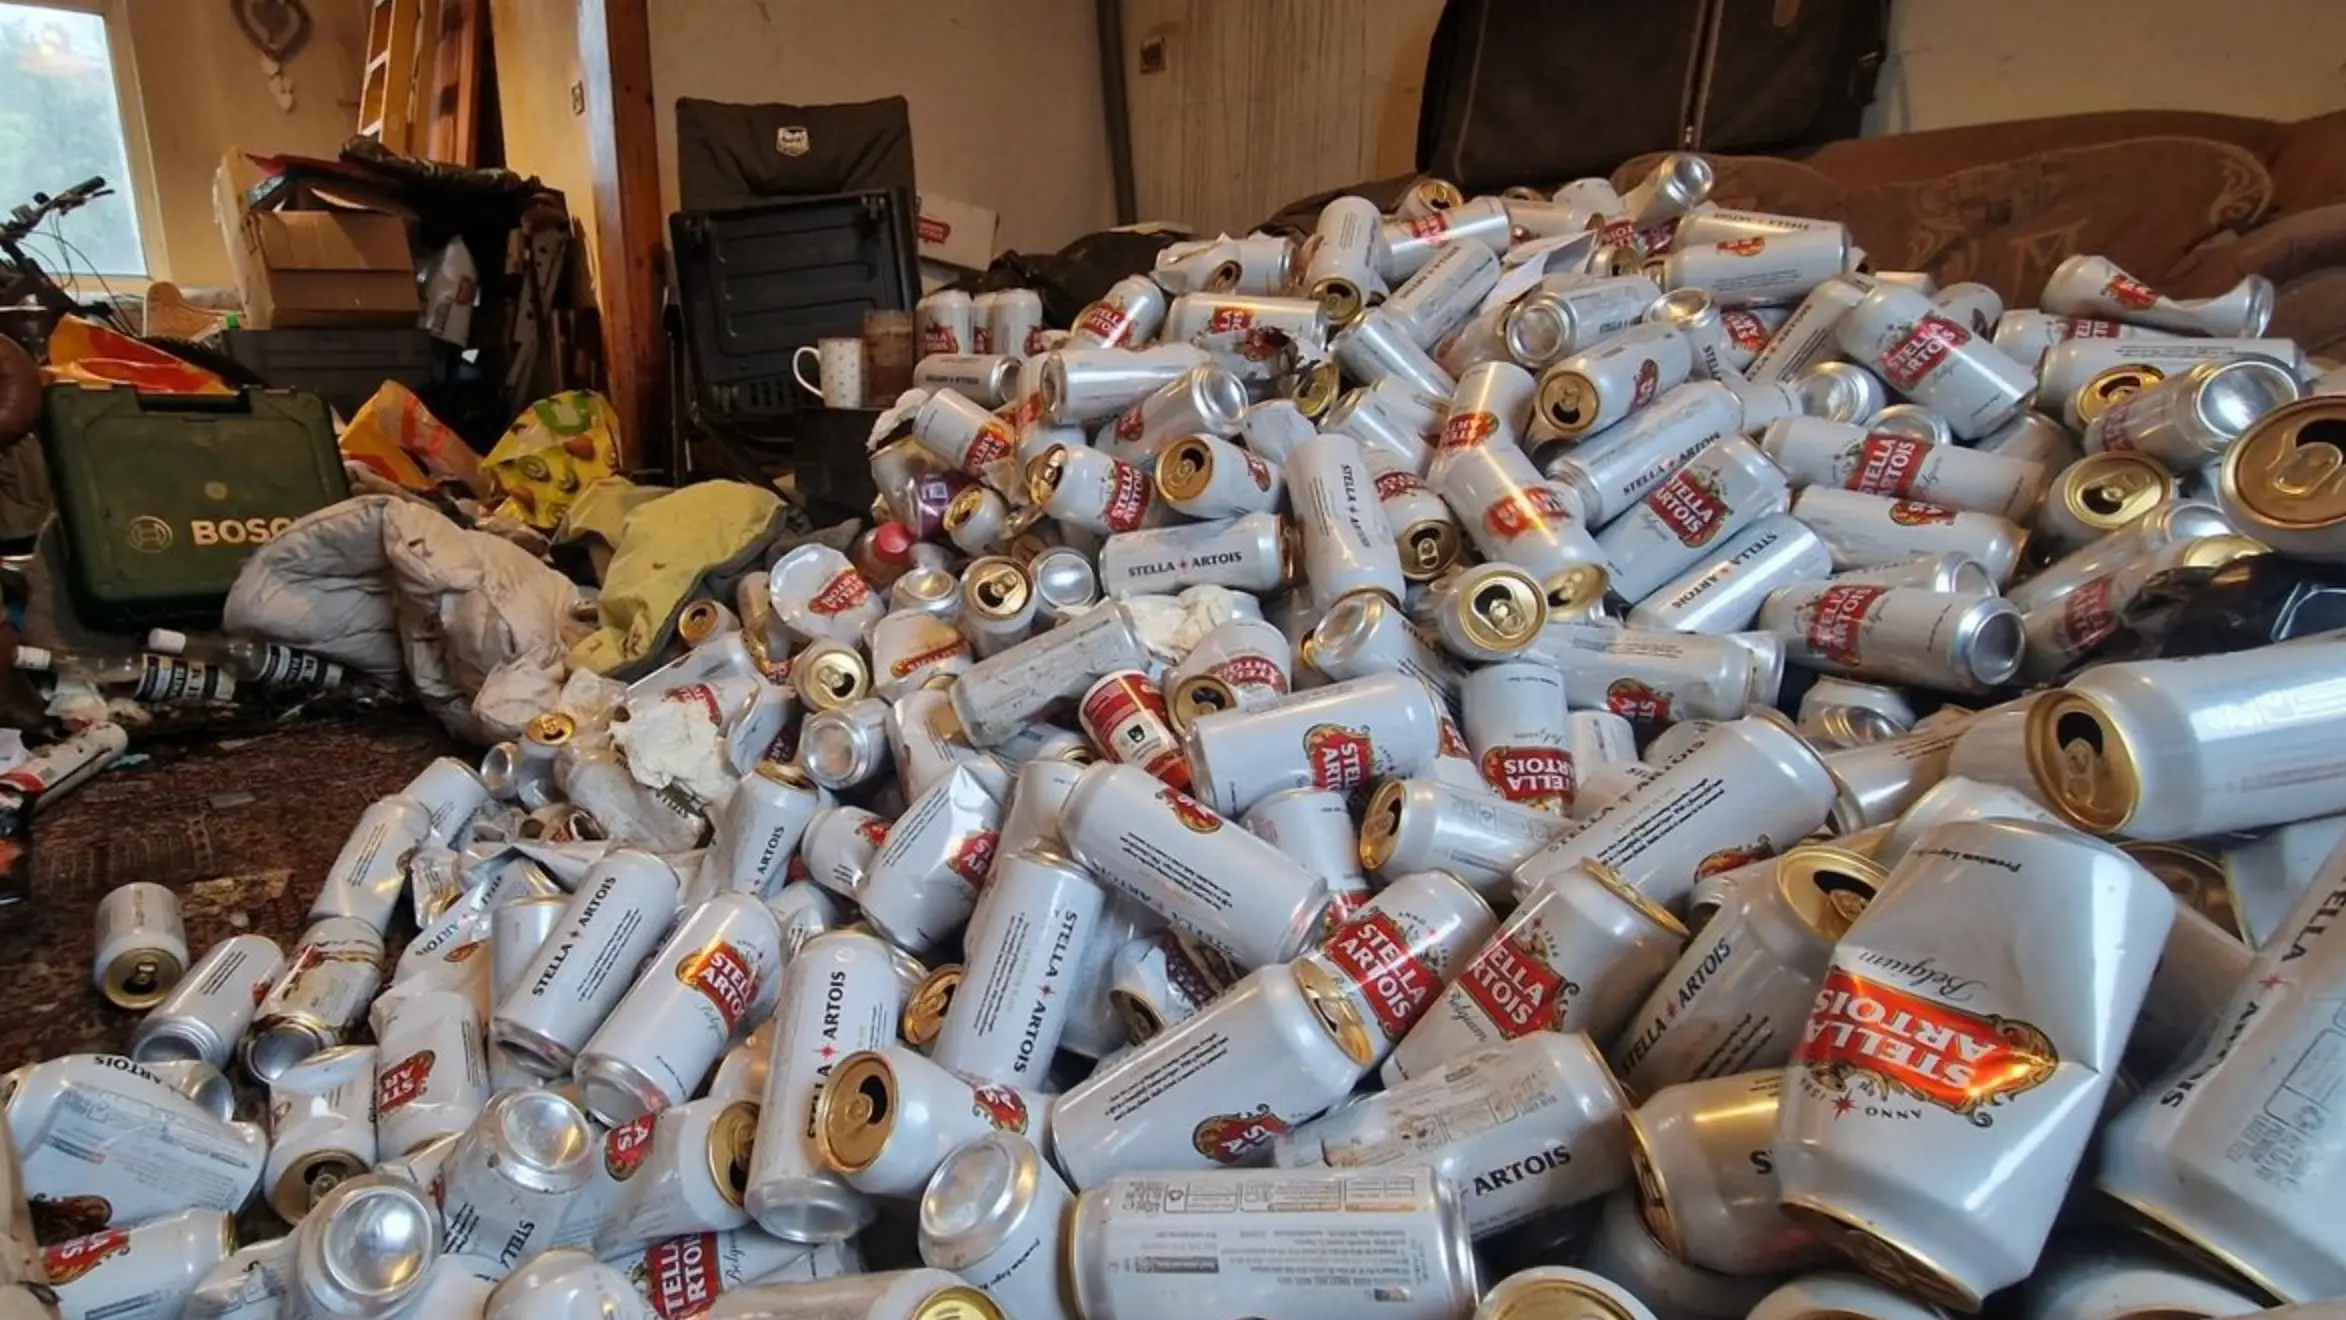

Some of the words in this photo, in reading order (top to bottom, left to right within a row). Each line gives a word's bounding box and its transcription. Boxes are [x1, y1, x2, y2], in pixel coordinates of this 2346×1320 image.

[1887, 314, 1943, 376] STELLA
[1899, 323, 1956, 387] ARTOIS
[1110, 463, 1132, 519] STELLA
[1342, 464, 1359, 503] STELLA
[1622, 463, 1667, 496] STELLA
[1678, 432, 1721, 463] ARTOIS
[191, 516, 302, 546] BOSC
[1729, 532, 1779, 573] STELLA
[1128, 561, 1176, 577] STELLA
[1191, 551, 1243, 568] ARTOIS
[1672, 574, 1721, 608] ARTOIS
[758, 825, 786, 876] ARTOIS
[531, 943, 574, 996] STELLA
[579, 875, 617, 928] ARTOIS
[1045, 910, 1078, 980] STELLA
[2281, 876, 2346, 962] ELLA
[701, 966, 747, 1016] ARTO
[1340, 939, 1412, 1019] ARTOIS
[1356, 923, 1432, 1005] STELLA
[1467, 950, 1535, 1023] RTOIS
[1858, 950, 1988, 1001] Belgium
[823, 970, 846, 1039] ARTOIS
[1621, 1018, 1668, 1074] STELLA
[1677, 936, 1732, 1006] ARTOIS
[1813, 989, 1998, 1063] ARTOIS
[1013, 1000, 1048, 1074] ARTOIS
[1804, 1019, 1977, 1089] STELLA
[94, 1055, 163, 1085] ARTOIS
[1864, 1106, 1922, 1120] ANNO
[1471, 1143, 1572, 1197] ARTOIS
